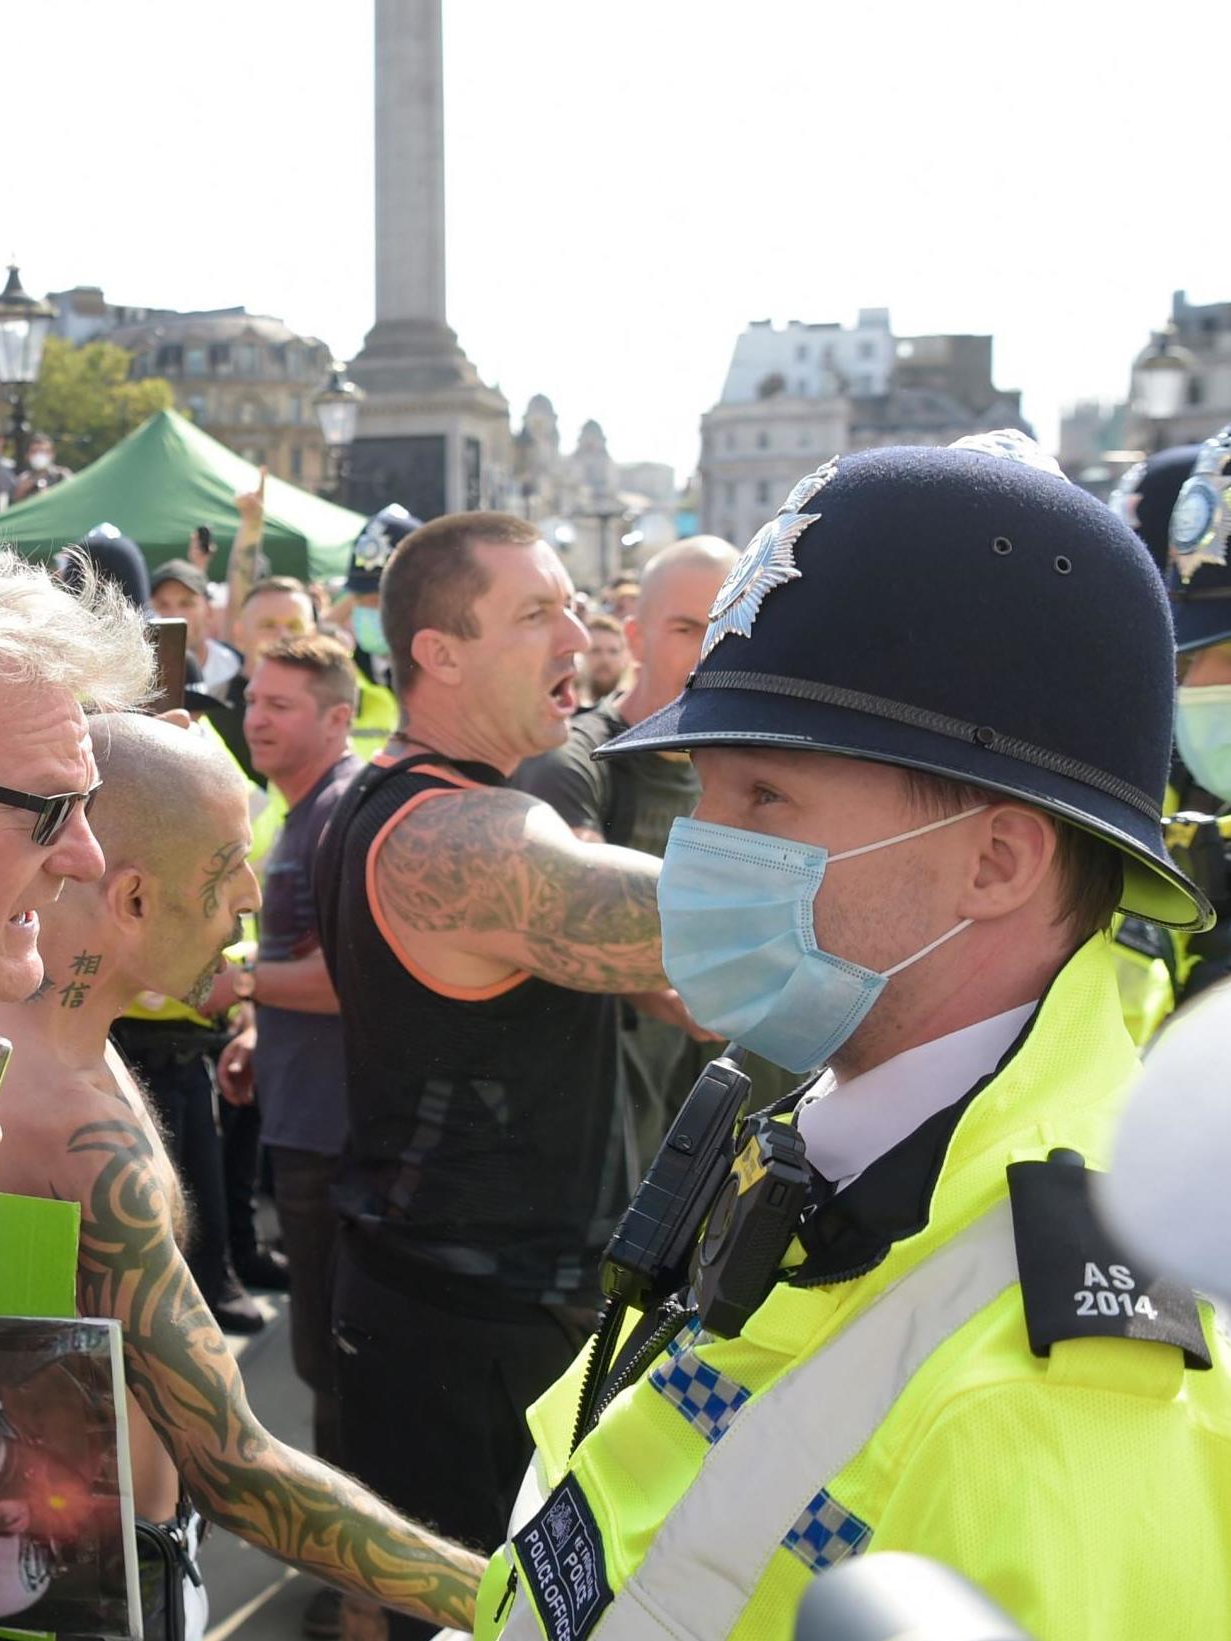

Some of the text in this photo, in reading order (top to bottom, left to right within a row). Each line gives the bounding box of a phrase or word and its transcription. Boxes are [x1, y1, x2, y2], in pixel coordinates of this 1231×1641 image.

[57, 949, 102, 1008] 相信
[1073, 1290, 1158, 1320] 2014
[1084, 1262, 1135, 1290] AS
[524, 1528, 571, 1641] POLICE OFFICE
[562, 1551, 588, 1610] POLICE
